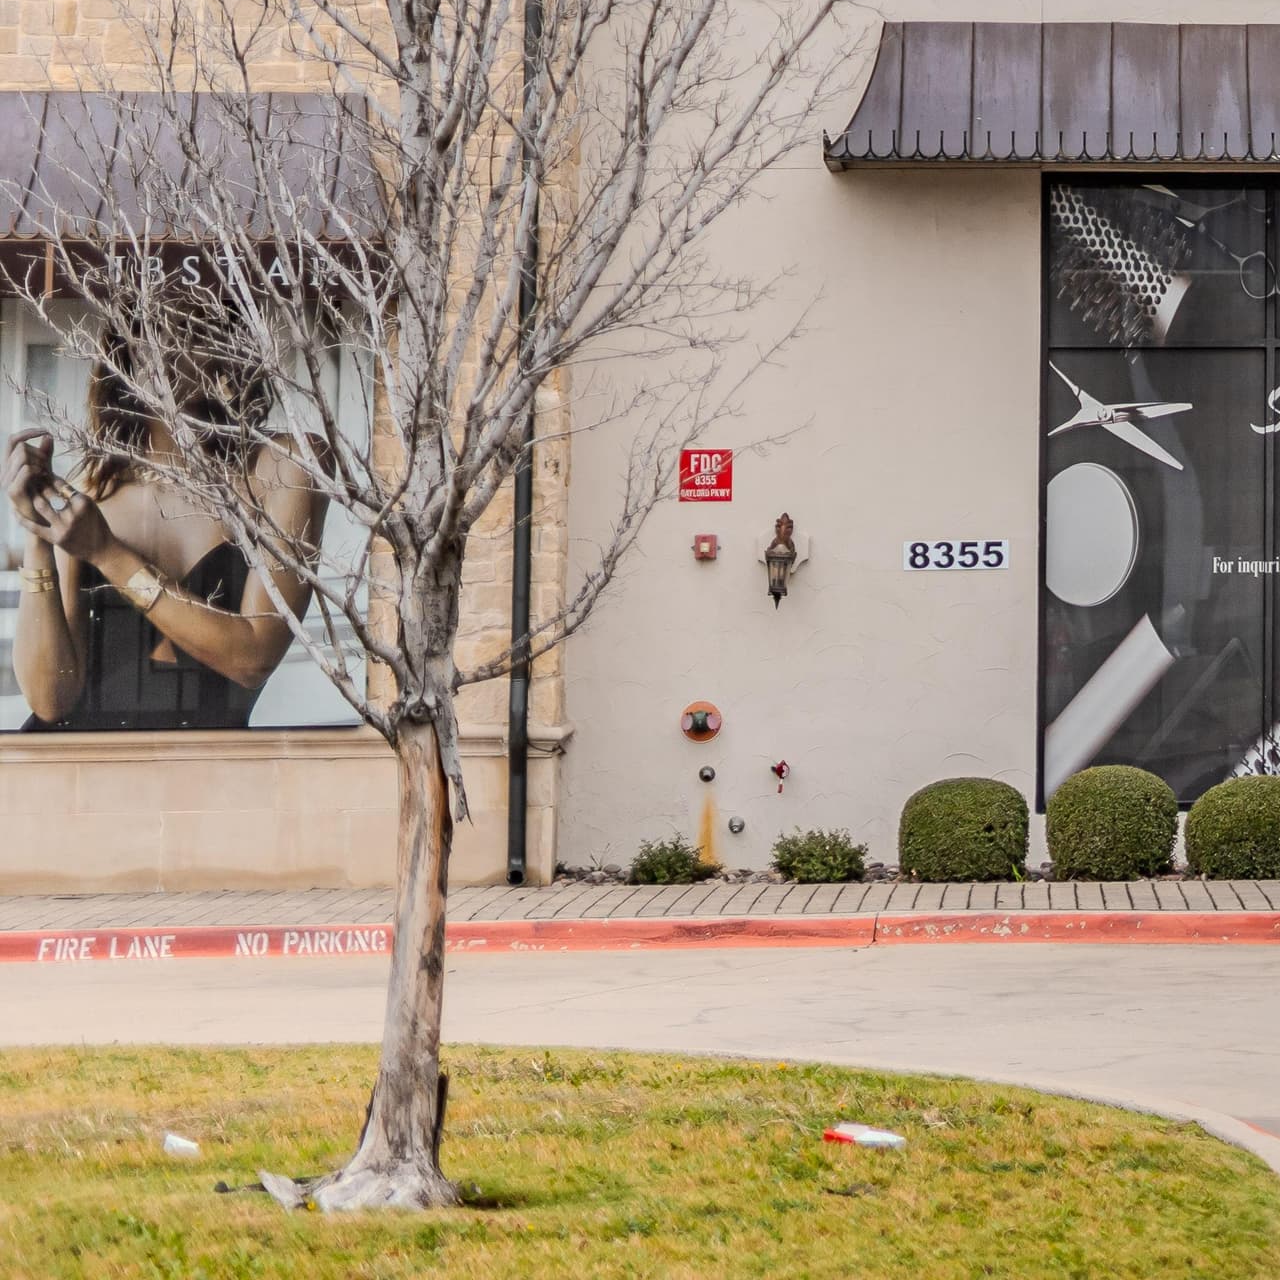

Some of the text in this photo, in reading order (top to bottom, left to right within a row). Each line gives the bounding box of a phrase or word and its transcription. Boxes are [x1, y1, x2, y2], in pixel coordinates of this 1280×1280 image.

[690, 454, 722, 473] FDC
[695, 475, 717, 485] 8355
[909, 541, 1004, 569] 8355
[1213, 556, 1234, 573] For
[38, 929, 387, 961] FIRE LANE NO PARKING
